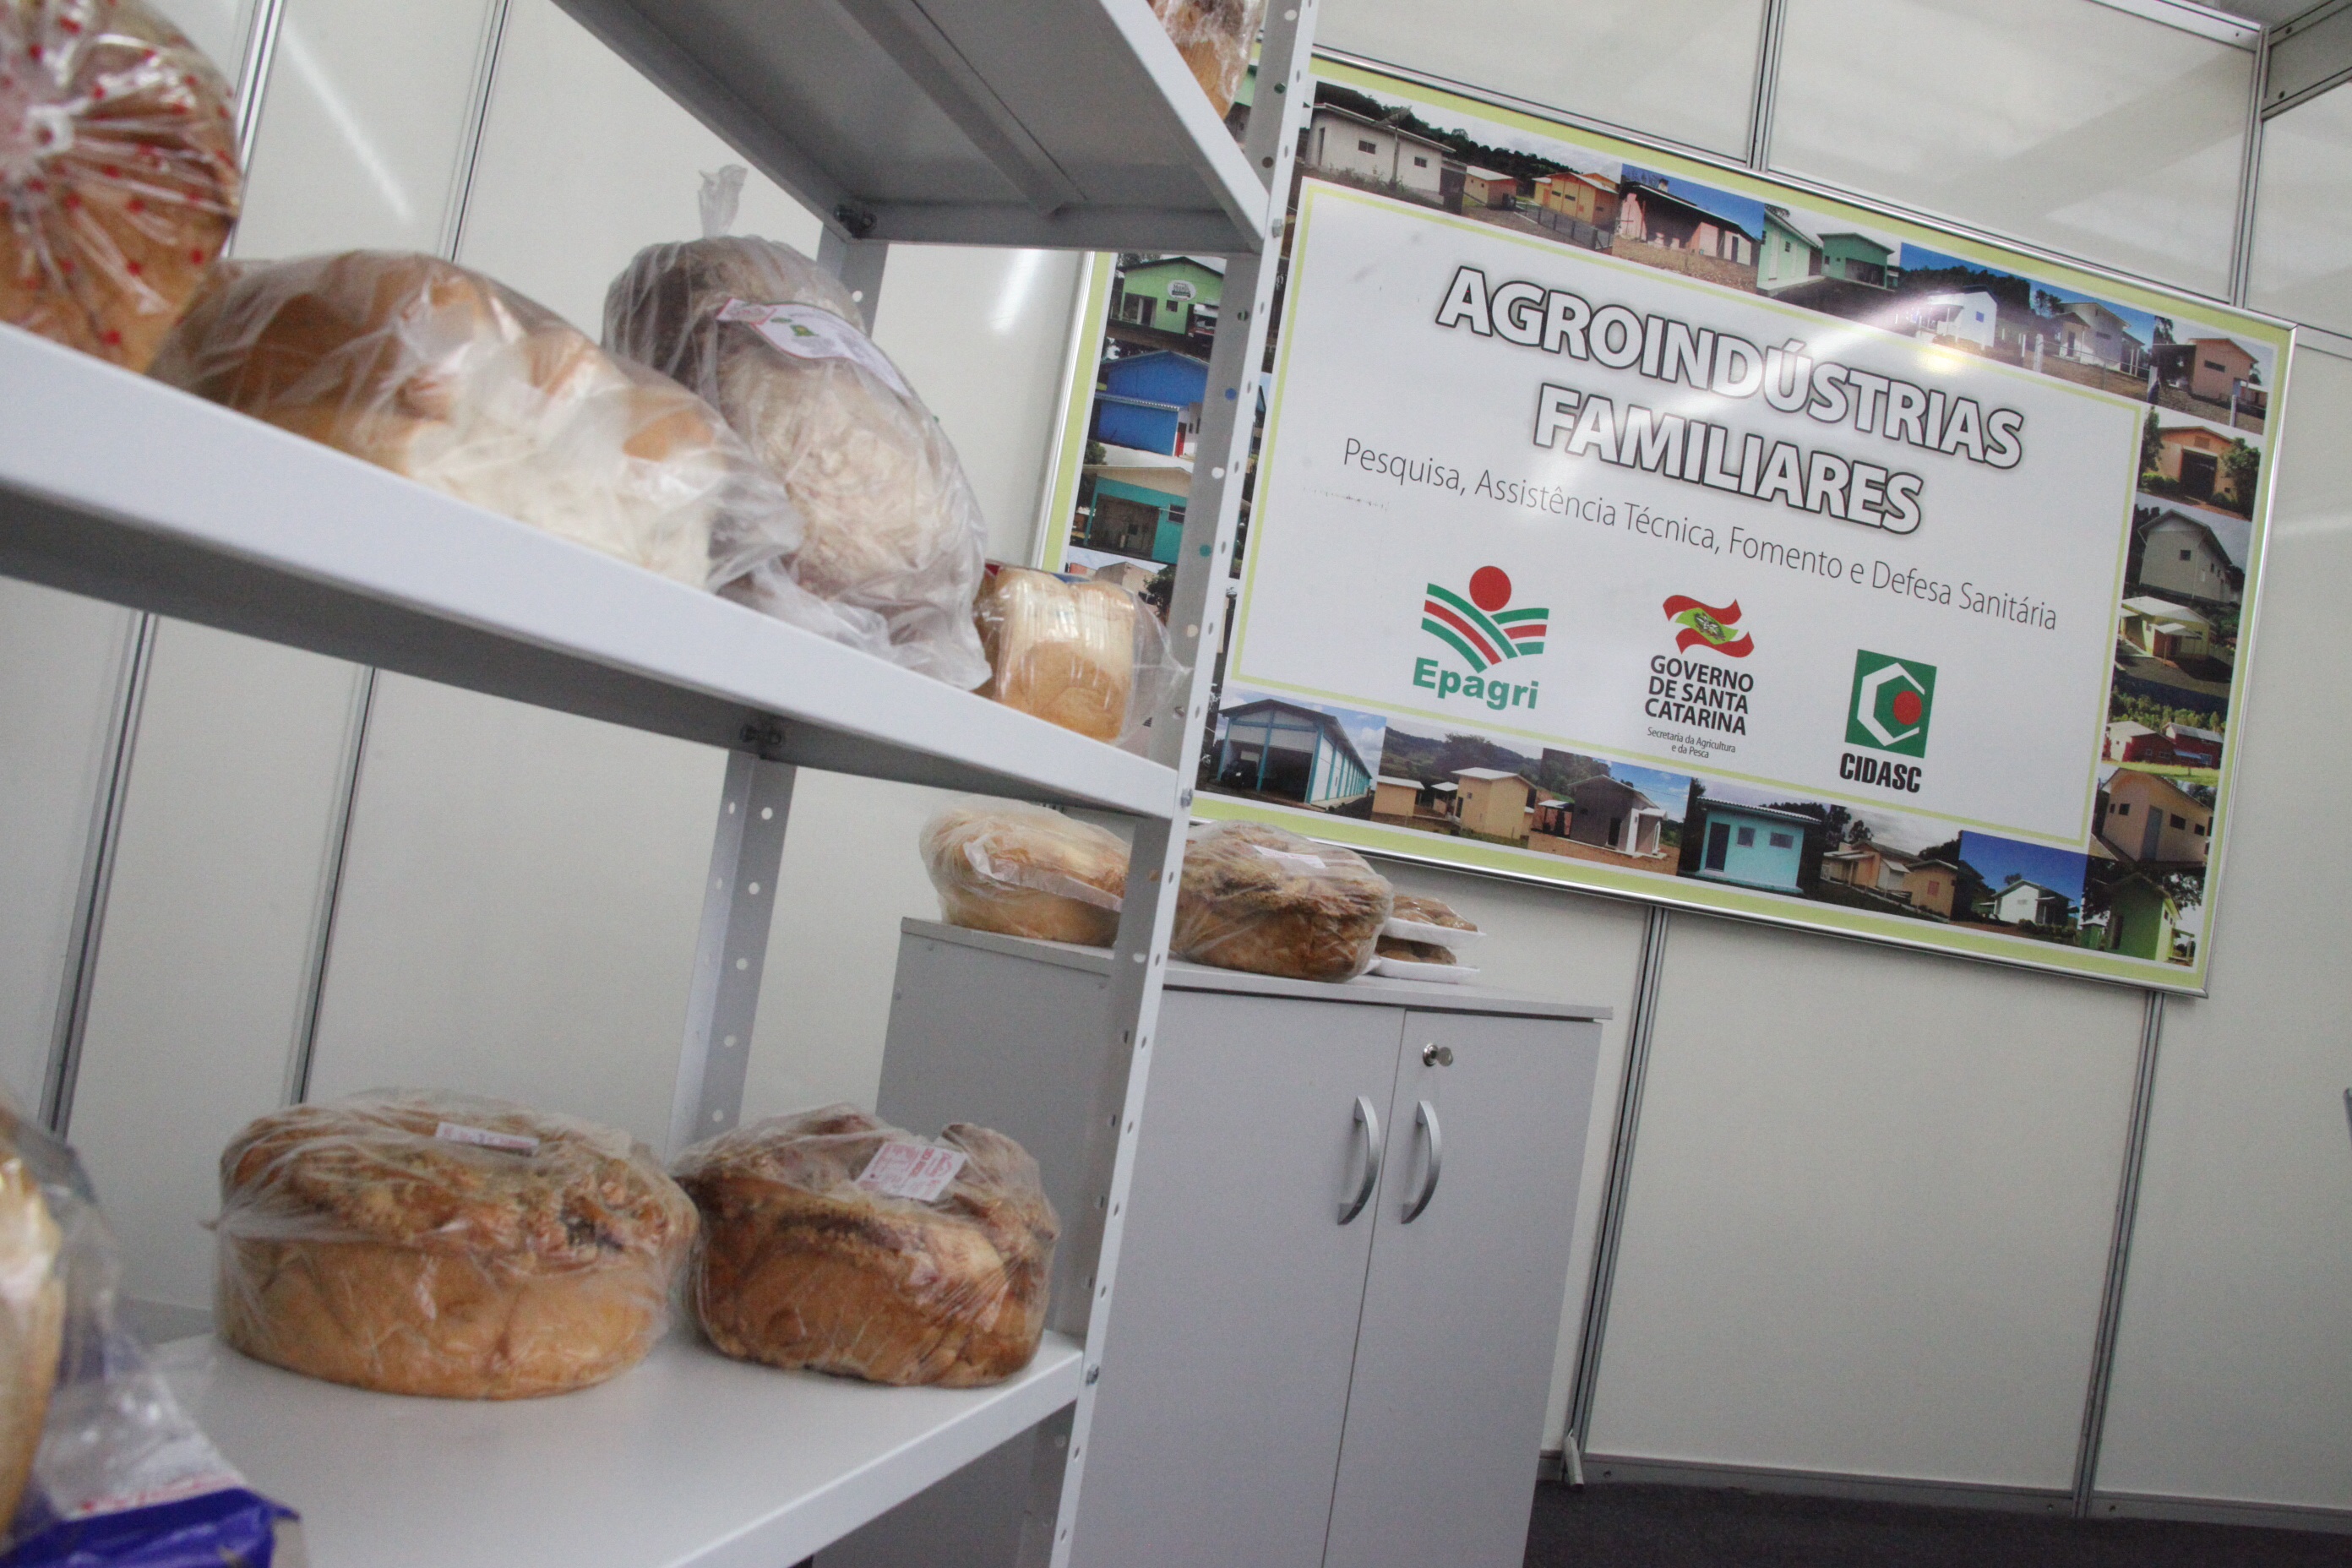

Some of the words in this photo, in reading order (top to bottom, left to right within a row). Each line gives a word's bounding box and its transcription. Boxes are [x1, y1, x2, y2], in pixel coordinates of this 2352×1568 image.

[1435, 266, 2023, 469] AGROINDÚSTRIAS
[1533, 383, 1923, 535] FAMILIARES
[1343, 438, 1466, 496] Pesquisa,
[1474, 469, 1615, 527] Assistência
[1624, 502, 1720, 555] Técnica,
[1729, 526, 1843, 580] Fomento
[1849, 562, 1865, 584] e
[1872, 560, 1951, 605] Defesa
[1959, 582, 2056, 630] Sanitária
[1413, 656, 1539, 710] Epagri
[1650, 655, 1754, 693] GOVERNO
[1648, 675, 1676, 699] DE
[1682, 683, 1749, 715] SANTA
[1644, 698, 1746, 736] CATARINA
[1647, 727, 1683, 743] Secretaria
[1685, 734, 1694, 744] da
[1696, 737, 1735, 753] Agricultura
[1678, 744, 1687, 754] da
[1689, 746, 1709, 758] Pesca
[1839, 752, 1922, 794] CIDASC
